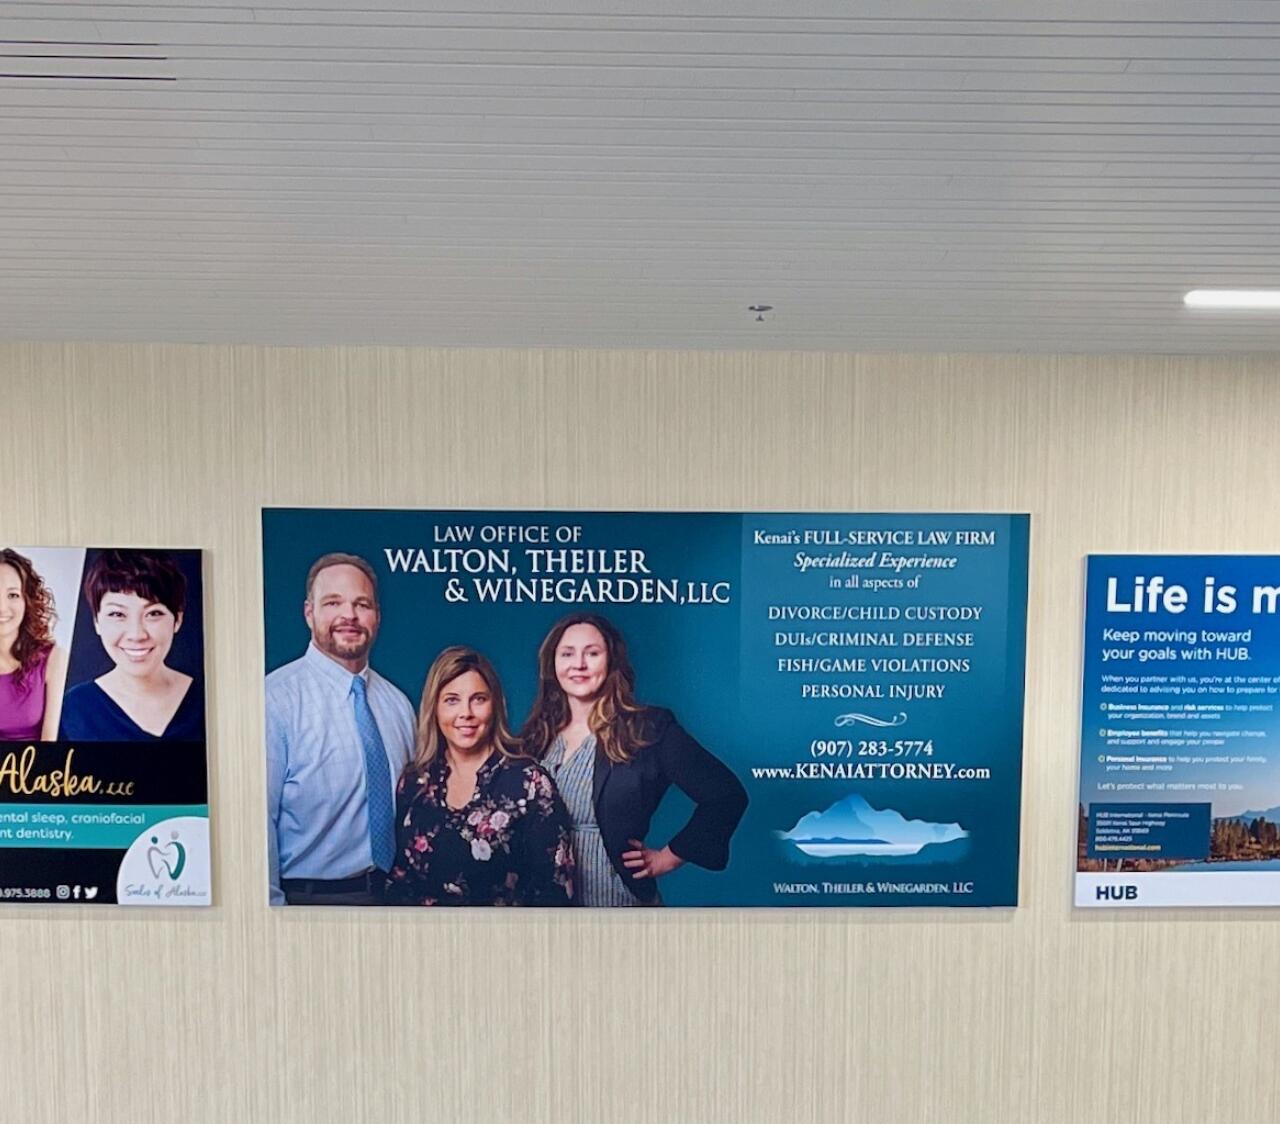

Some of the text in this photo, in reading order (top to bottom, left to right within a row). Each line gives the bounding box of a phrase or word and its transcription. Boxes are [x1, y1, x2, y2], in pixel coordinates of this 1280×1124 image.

[434, 526, 582, 543] LAW OFFICE OF
[754, 531, 995, 545] Kenai's FULL-SERVICE LAW FIRM
[385, 549, 650, 575] WALTON, THEILER
[794, 552, 957, 572] Specialized Experience
[445, 579, 469, 602] &
[830, 575, 922, 591] in all aspects of
[1106, 577, 1188, 614] Life
[1204, 577, 1237, 614] is
[769, 606, 982, 620] DIVORCE/CHILD CUSTODY
[775, 633, 974, 646] DUIs/CRIMINAL DEFENSE
[1103, 629, 1252, 644] Keep moving toward
[1102, 647, 1252, 661] your goals with HUB.
[778, 659, 970, 672] FISH/GAME VIOLATIONS
[801, 684, 945, 700] PERSONAL INJURY
[810, 740, 934, 758] (907) 283-5774
[752, 763, 991, 779] www.KENAIATTORNEY.com
[31, 811, 68, 824] sleep,
[72, 811, 145, 824] craniofacial
[16, 828, 74, 841] dentistry.
[1096, 886, 1138, 900] HUB
